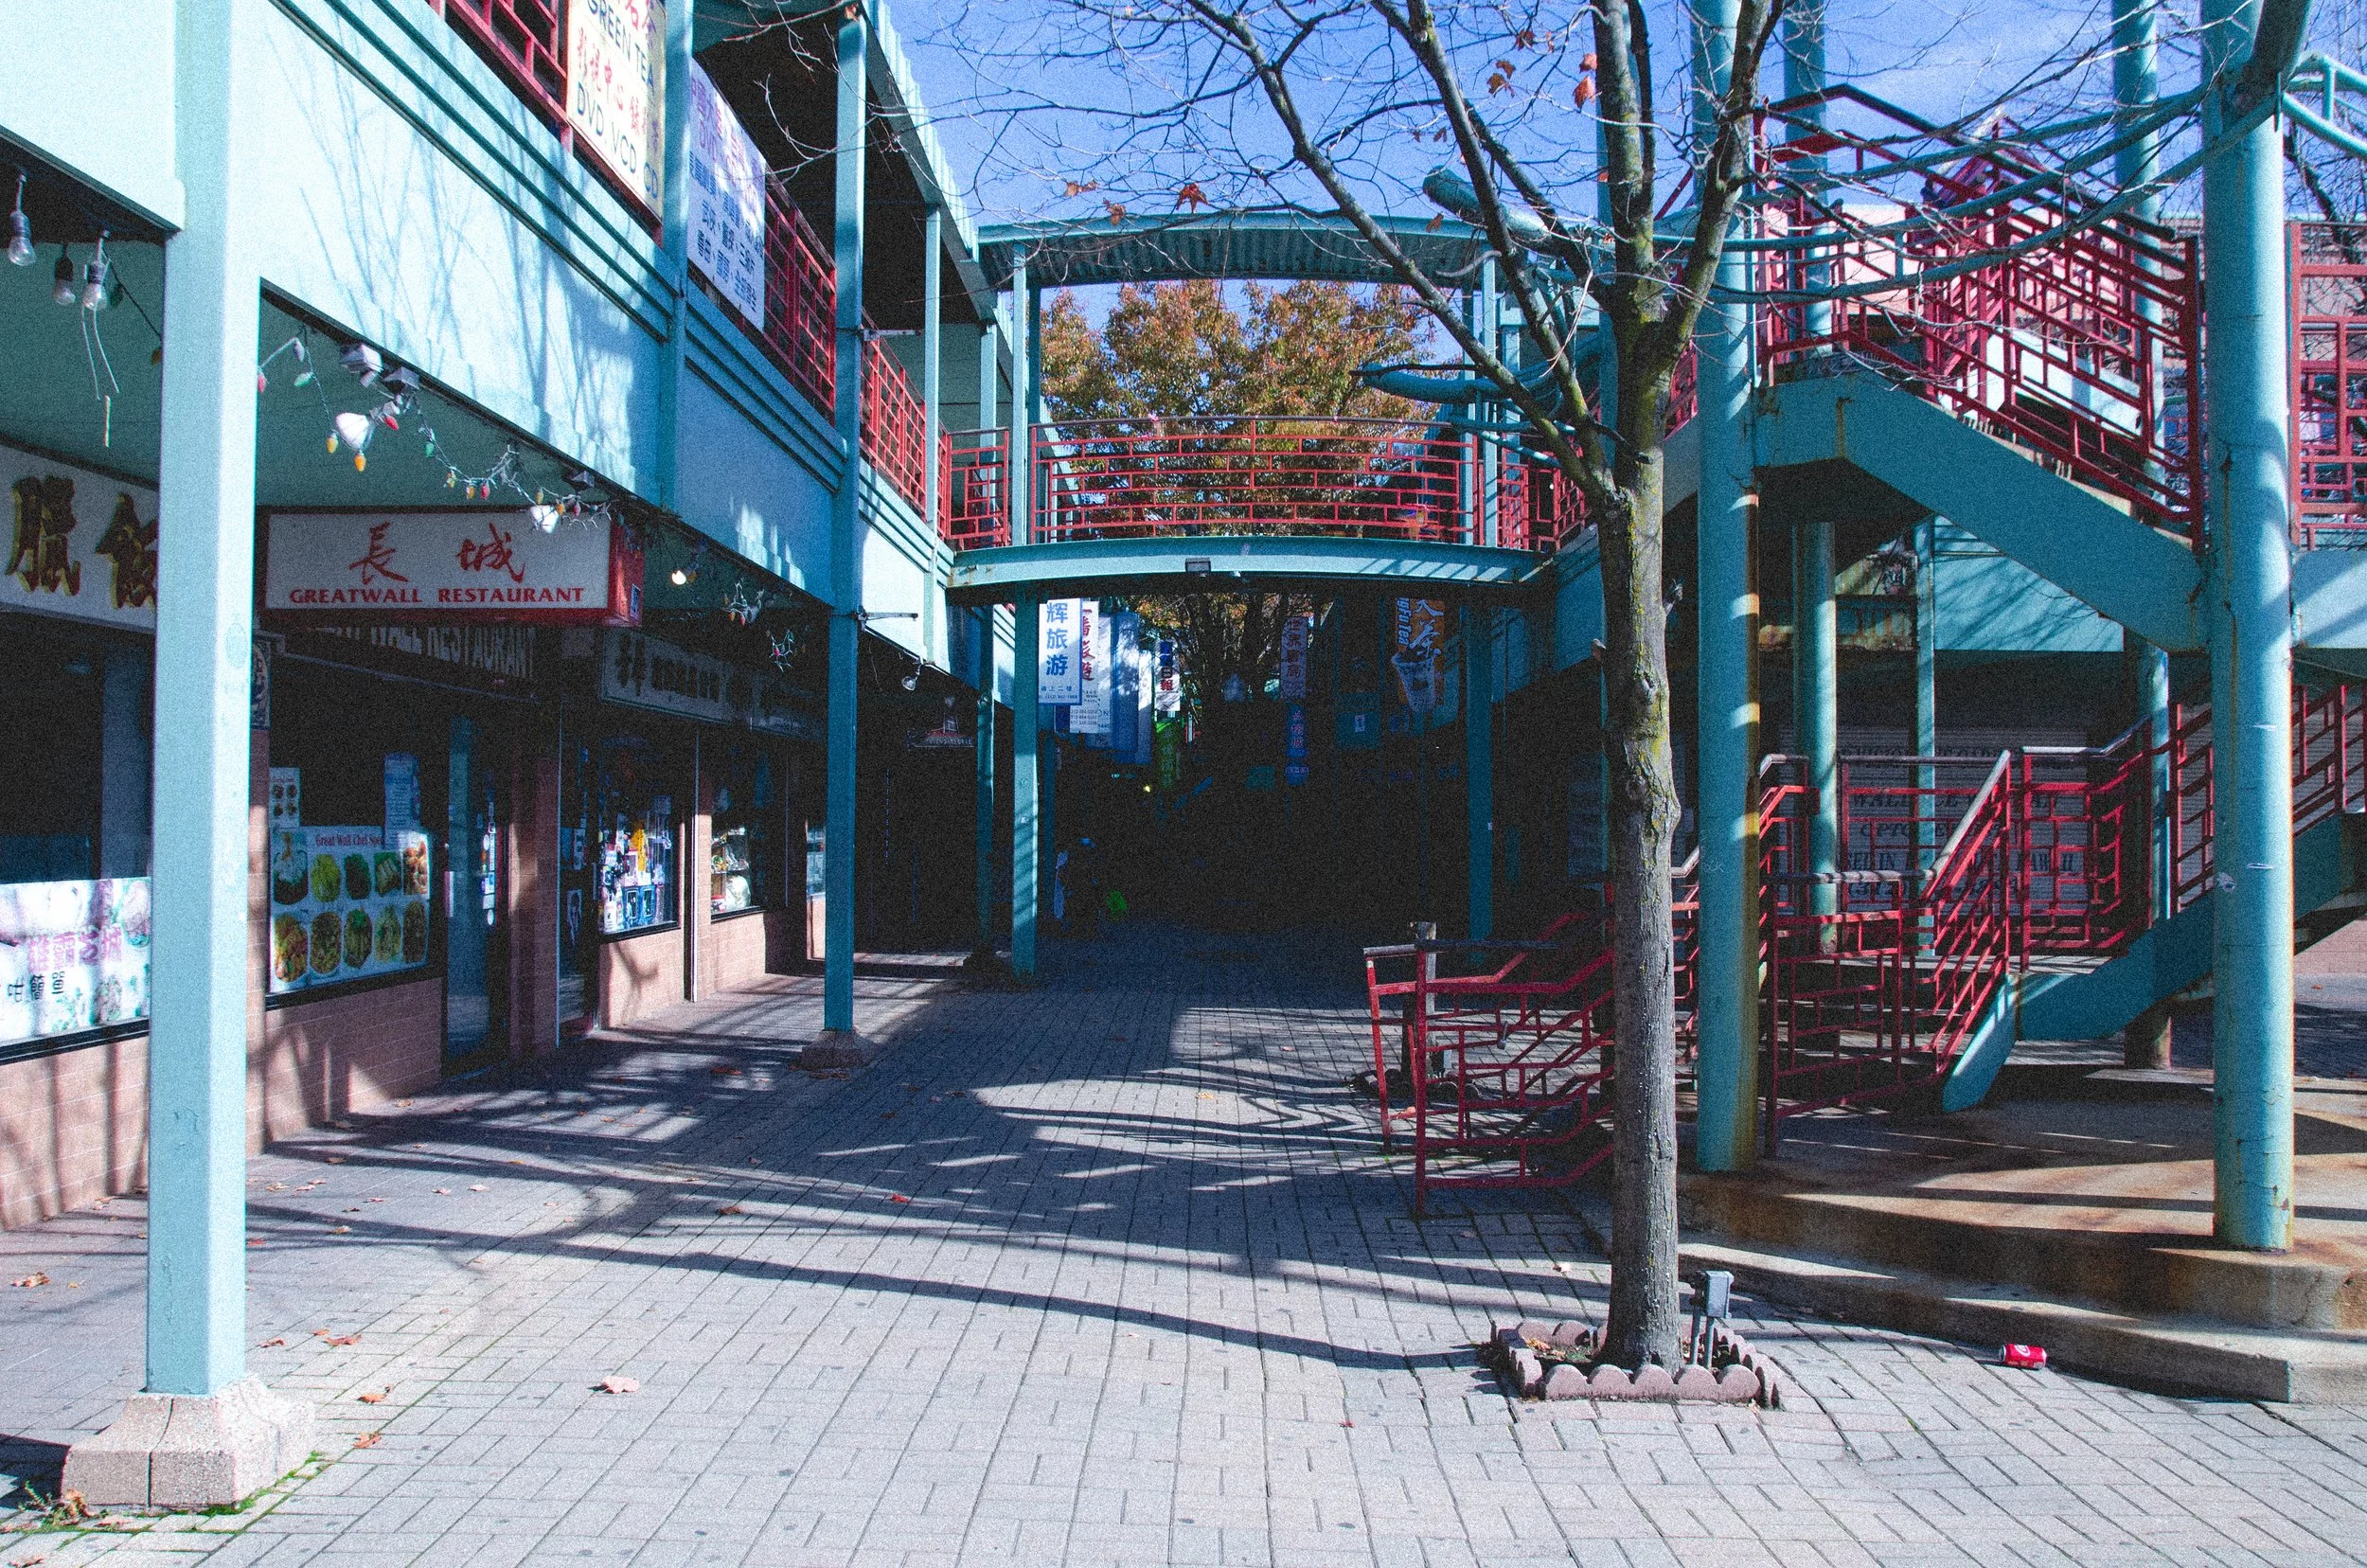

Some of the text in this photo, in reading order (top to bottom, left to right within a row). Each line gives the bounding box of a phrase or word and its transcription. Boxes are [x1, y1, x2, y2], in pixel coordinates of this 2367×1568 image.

[634, 42, 655, 95] TEA
[643, 161, 658, 199] CD
[348, 521, 525, 585] 長城
[289, 587, 584, 604] GREATWALL RESTAURANT
[1046, 602, 1068, 676] 辉旅游
